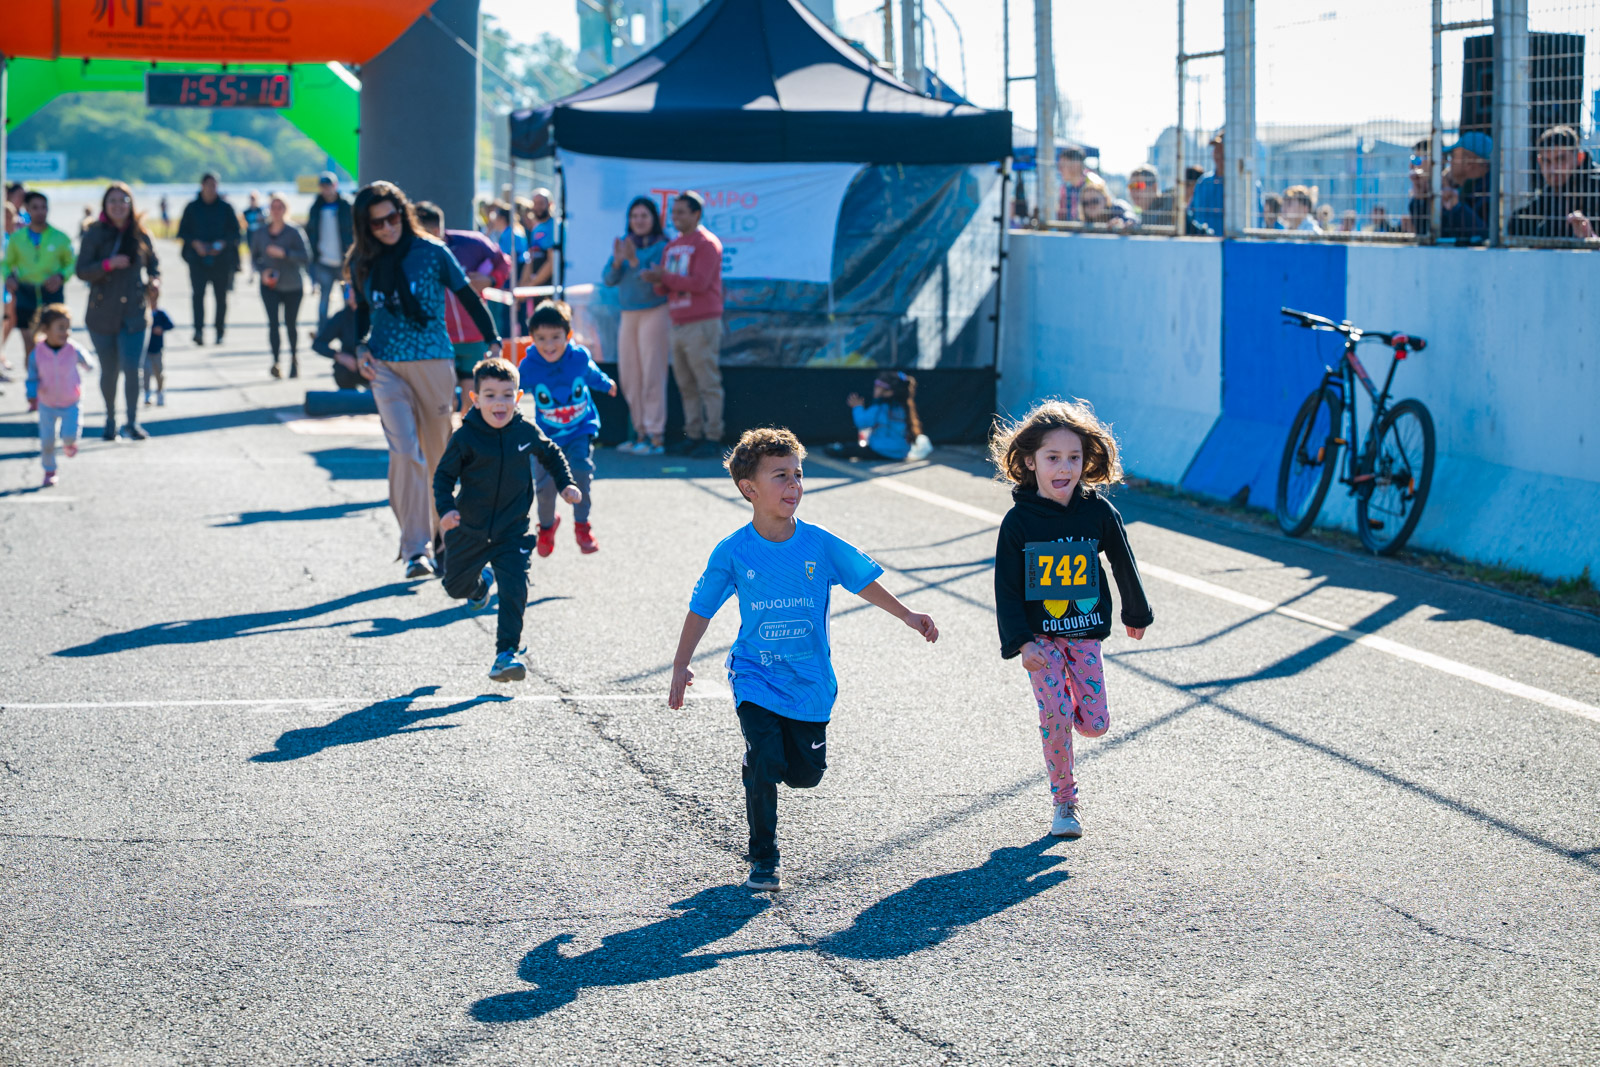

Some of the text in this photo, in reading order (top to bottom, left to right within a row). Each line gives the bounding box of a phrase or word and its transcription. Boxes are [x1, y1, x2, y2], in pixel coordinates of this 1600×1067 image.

[144, 1, 292, 33] EXACTO
[1028, 552, 1036, 589] TIEMPO
[1038, 554, 1087, 586] 742
[1042, 612, 1104, 632] COLOURFUL
